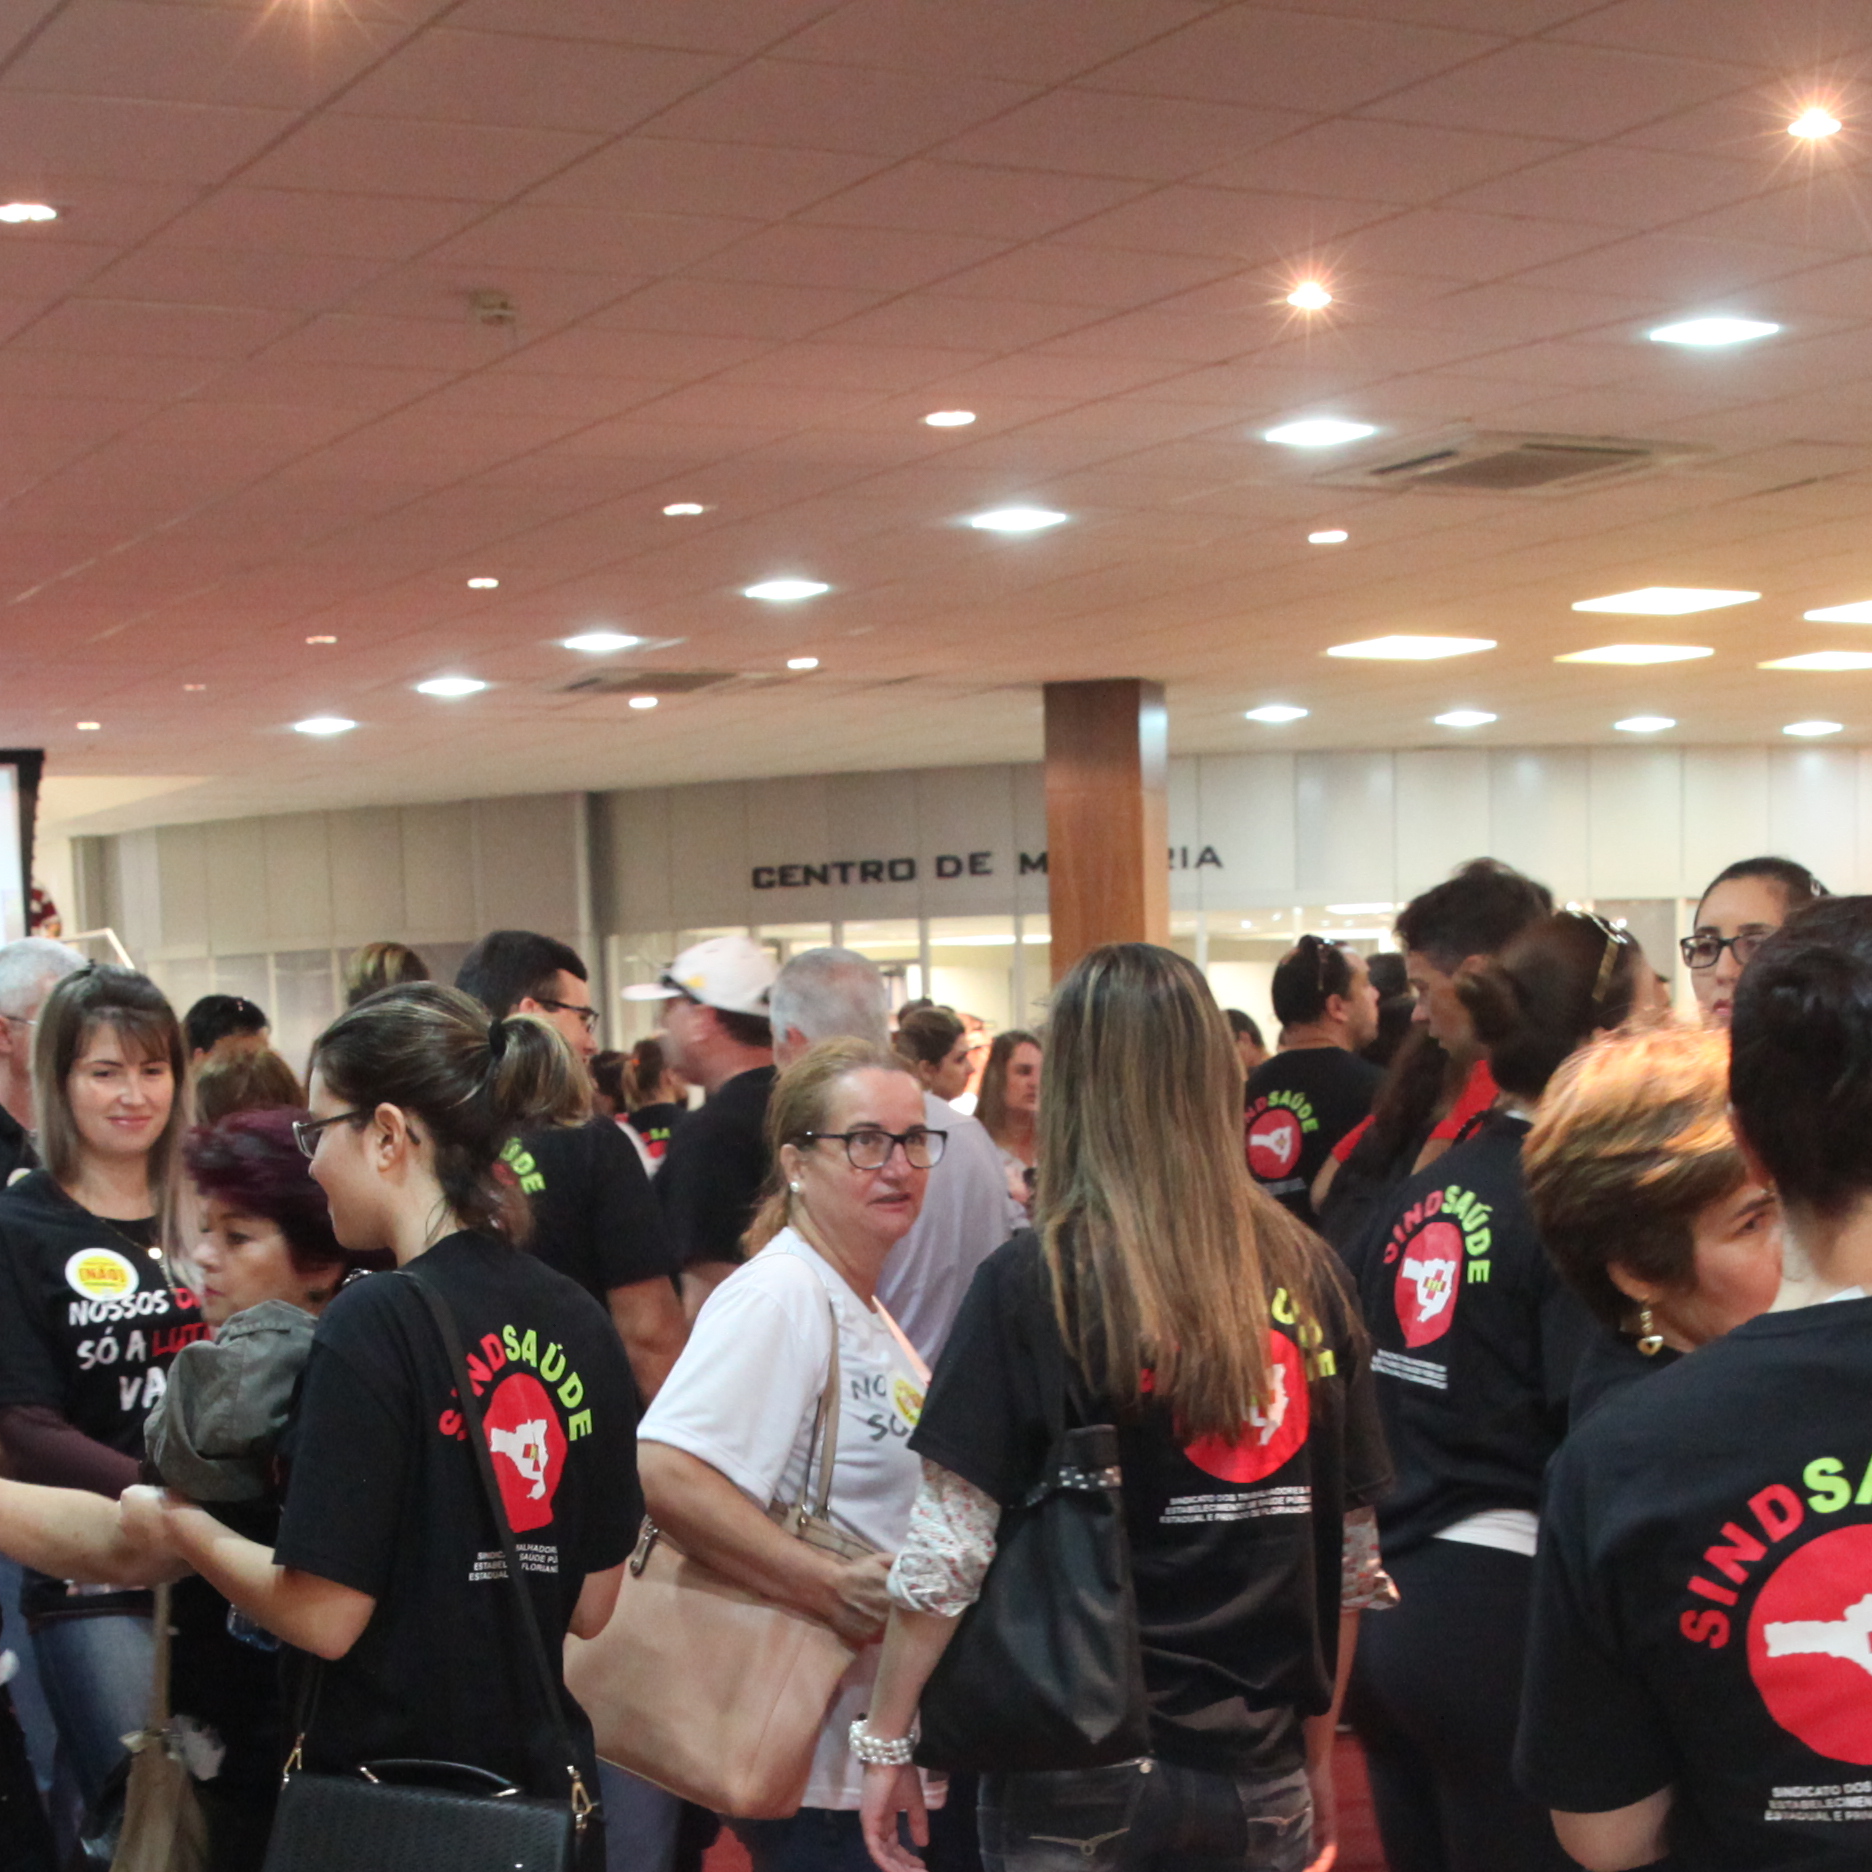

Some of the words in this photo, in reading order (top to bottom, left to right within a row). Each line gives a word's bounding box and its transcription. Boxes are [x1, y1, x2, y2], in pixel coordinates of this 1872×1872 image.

[752, 856, 916, 889] CENTRO
[935, 851, 992, 879] DE
[68, 1289, 170, 1327] NOSSOS
[76, 1326, 120, 1370] SÓ
[125, 1329, 147, 1363] A
[438, 1324, 593, 1442] SNDSAÚDE
[473, 1561, 508, 1571] ESTABEL
[1771, 1785, 1841, 1798] SINDICATO
[1843, 1781, 1872, 1793] DOS
[1833, 1811, 1843, 1821] E
